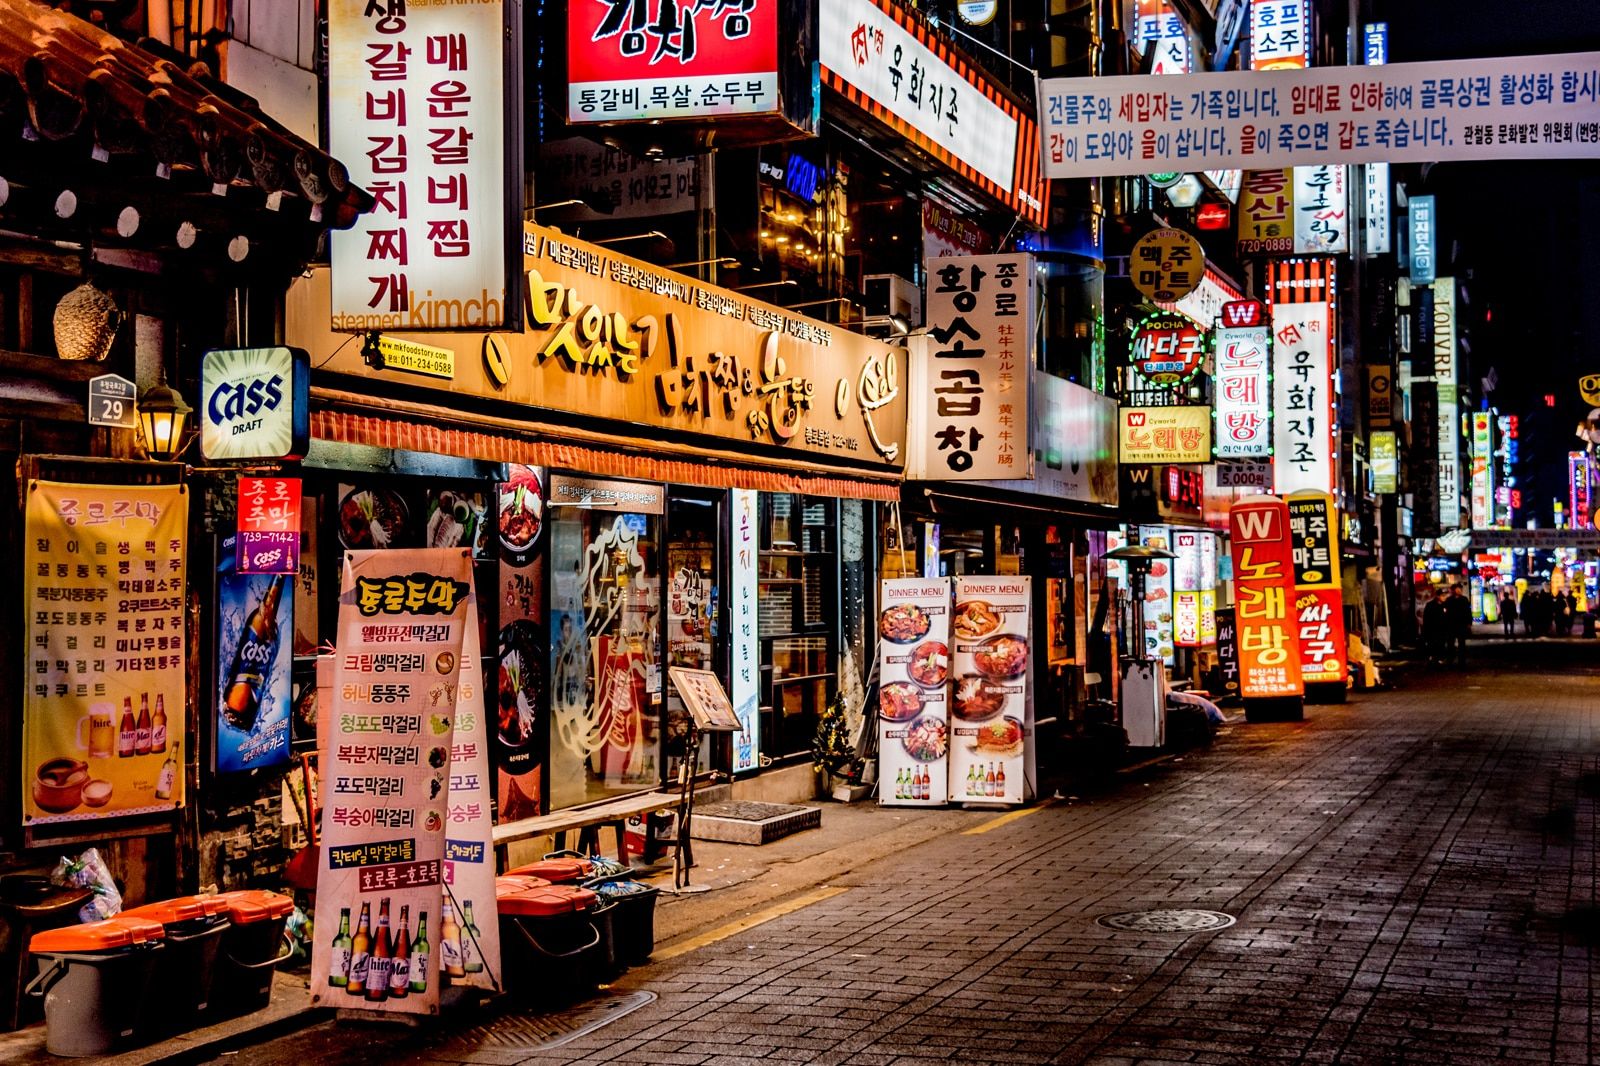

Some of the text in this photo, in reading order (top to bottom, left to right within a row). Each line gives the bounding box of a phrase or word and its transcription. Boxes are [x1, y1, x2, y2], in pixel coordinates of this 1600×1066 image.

[1257, 4, 1299, 28] 호프
[1257, 29, 1300, 53] 소주
[887, 44, 959, 137] 육회지존
[1048, 70, 1600, 125] 건물주와 세입자는 가족입니다. 임대료 인하하여 골목상권 활성화 합시
[426, 32, 473, 258] 매운갈비찜
[1050, 133, 1078, 163] 갑이
[1085, 130, 1133, 161] 도와야
[1141, 128, 1170, 160] 을이
[1175, 126, 1232, 158] 삽니다.
[1240, 124, 1270, 156] 을이
[1278, 121, 1329, 153] 죽으면
[1338, 121, 1369, 150] 갑도
[1374, 116, 1453, 148] 죽습니다.
[1463, 124, 1494, 146] 관철동
[1498, 123, 1538, 145] 문화발전
[1542, 121, 1573, 144] 위원회
[1245, 169, 1290, 221] 동산
[1140, 246, 1192, 266] 맥주
[1241, 238, 1292, 253] 720-0889
[994, 262, 1019, 317] 종로
[1140, 271, 1191, 290] 마트
[332, 311, 402, 330] steamed
[527, 269, 639, 375] 맛있는
[1146, 321, 1184, 330] POCHA
[1132, 332, 1202, 364] 싸다구
[1434, 300, 1451, 378] LOUVRE
[934, 263, 986, 473] 황소곱창
[208, 373, 284, 426] Cass
[1221, 342, 1265, 441] 노래방
[102, 399, 123, 420] 29
[1286, 350, 1317, 472] 육회지존
[232, 418, 263, 436] DRAFT
[1125, 427, 1204, 450] 노래방
[1129, 469, 1149, 483] W
[243, 479, 291, 505] 종로
[58, 499, 161, 528] 종로주막
[245, 501, 295, 529] 주막
[1236, 510, 1273, 539] W
[1290, 516, 1327, 539] 맥주
[36, 538, 108, 555] 참이슬
[117, 539, 181, 555] 생맥주
[243, 532, 295, 543] 739-7142
[1304, 536, 1315, 548] e
[118, 558, 181, 574] 병맥주
[1292, 547, 1330, 569] 마트
[888, 588, 944, 597] DINNER MENU
[963, 584, 1024, 594] DINNER MENU
[1238, 547, 1290, 665] 노래방
[35, 612, 107, 626] 포도동동주
[117, 616, 182, 632] 복분자주
[35, 634, 105, 649] 막걸리
[361, 624, 450, 642] 웰빙퓨전막걸리
[1299, 603, 1336, 662] 싸다구
[116, 635, 181, 653] 대나무통술
[1218, 625, 1238, 679] 싸다구
[115, 655, 181, 673] 기타전통주
[343, 653, 425, 672] 크림생막걸리
[343, 684, 411, 703] 허니동동주
[341, 714, 421, 734] 청포도막걸리
[337, 745, 419, 765] 복분자막걸리
[334, 776, 404, 796] 포도막걸리
[332, 807, 414, 828] 복숭아막걸리
[332, 844, 413, 867] 칵테일 막걸리를
[370, 957, 391, 971] hite
